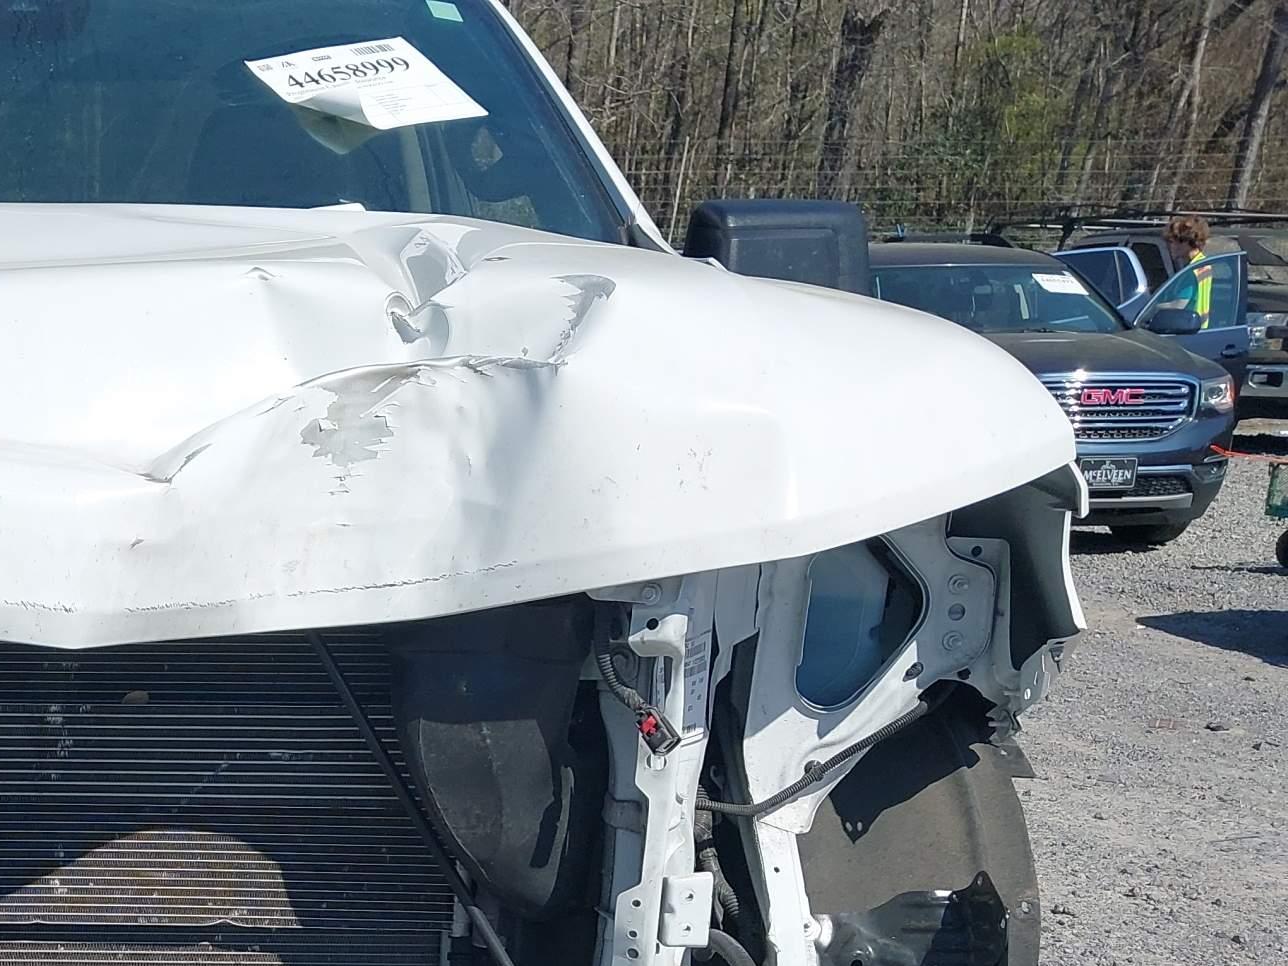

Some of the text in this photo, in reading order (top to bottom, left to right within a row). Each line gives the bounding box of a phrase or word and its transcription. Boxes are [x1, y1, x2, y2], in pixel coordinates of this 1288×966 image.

[287, 56, 410, 88] 44658999
[1081, 388, 1145, 405] GMC
[1083, 469, 1132, 482] McELVEEN
